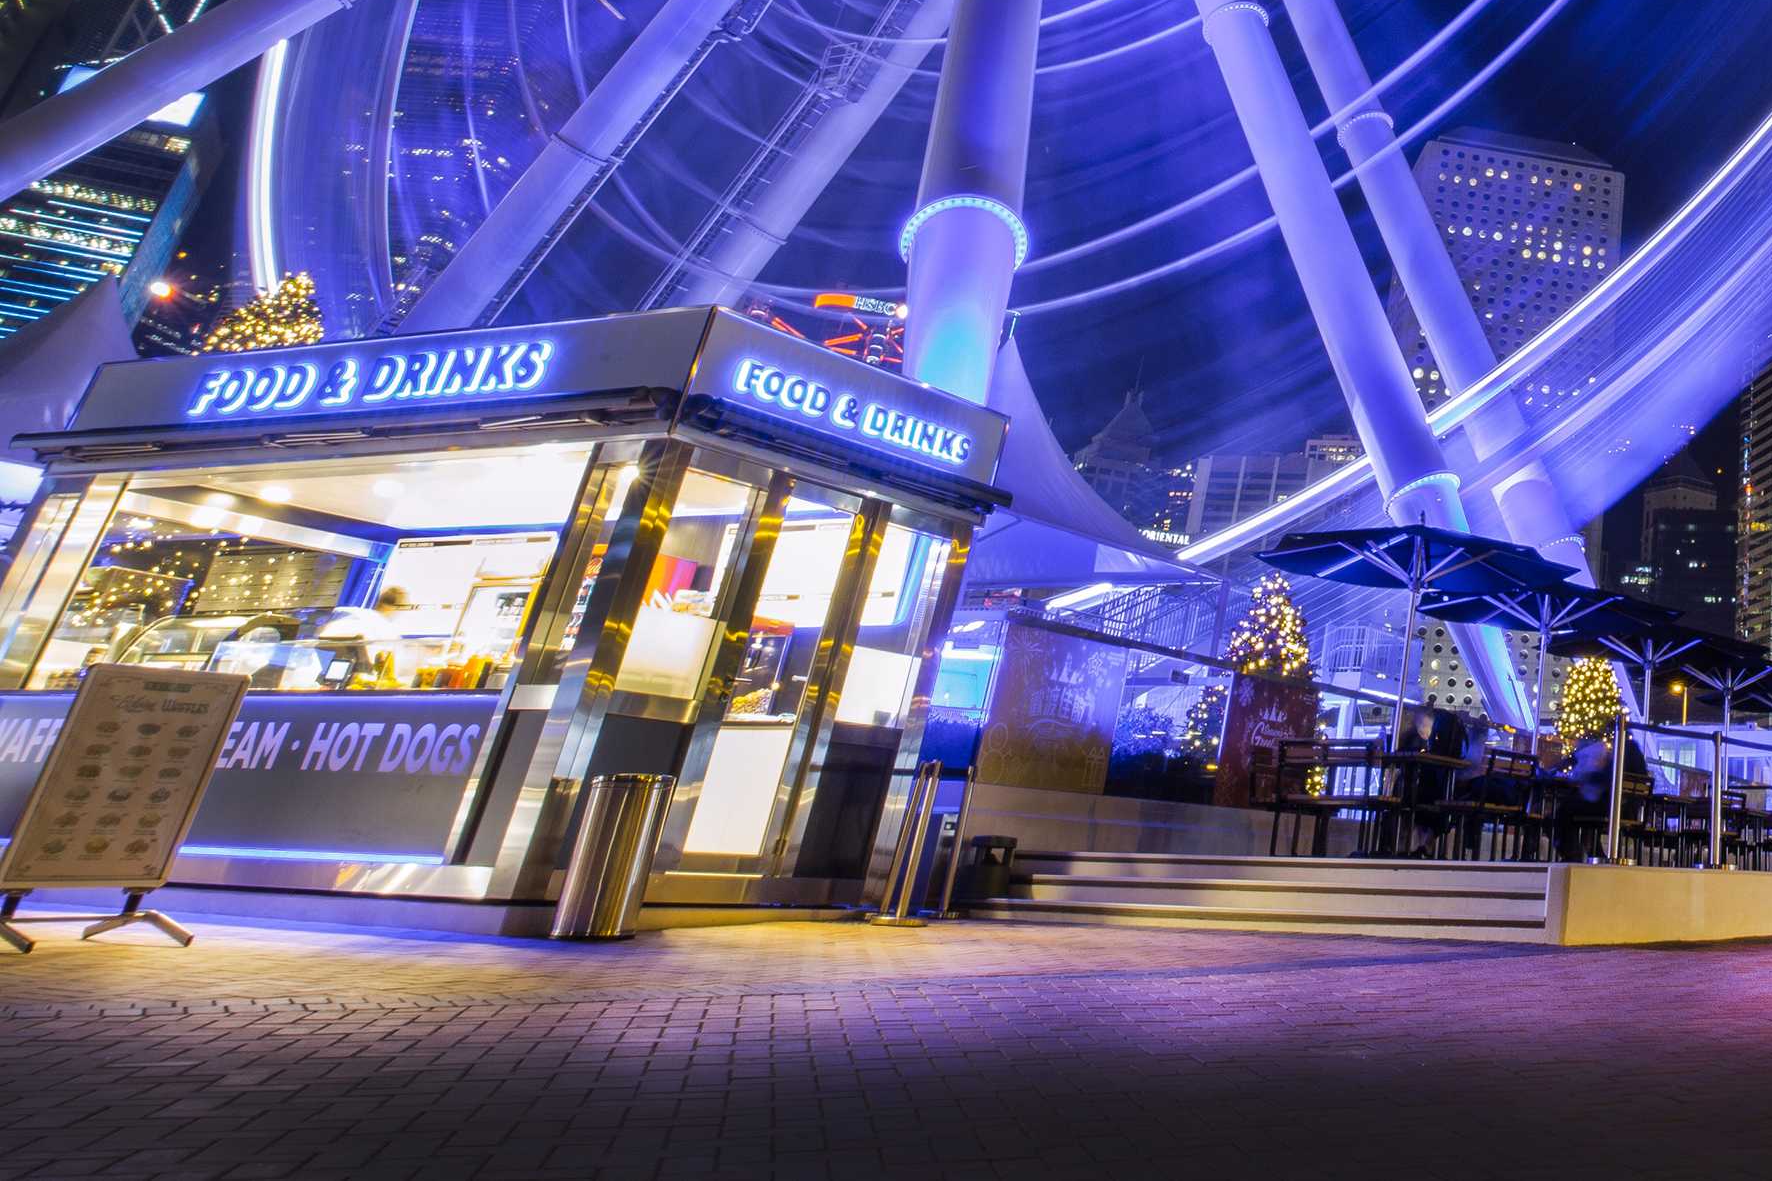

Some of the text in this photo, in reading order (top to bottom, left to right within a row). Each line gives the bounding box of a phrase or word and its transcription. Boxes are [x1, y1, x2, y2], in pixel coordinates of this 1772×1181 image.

[855, 295, 897, 316] HSBC
[188, 340, 553, 416] FOOD & DRINKS
[734, 359, 972, 464] FOOD & DRINKS
[1141, 529, 1190, 545] ORIENTAL
[300, 722, 386, 771] HOT
[376, 723, 481, 773] DOGS
